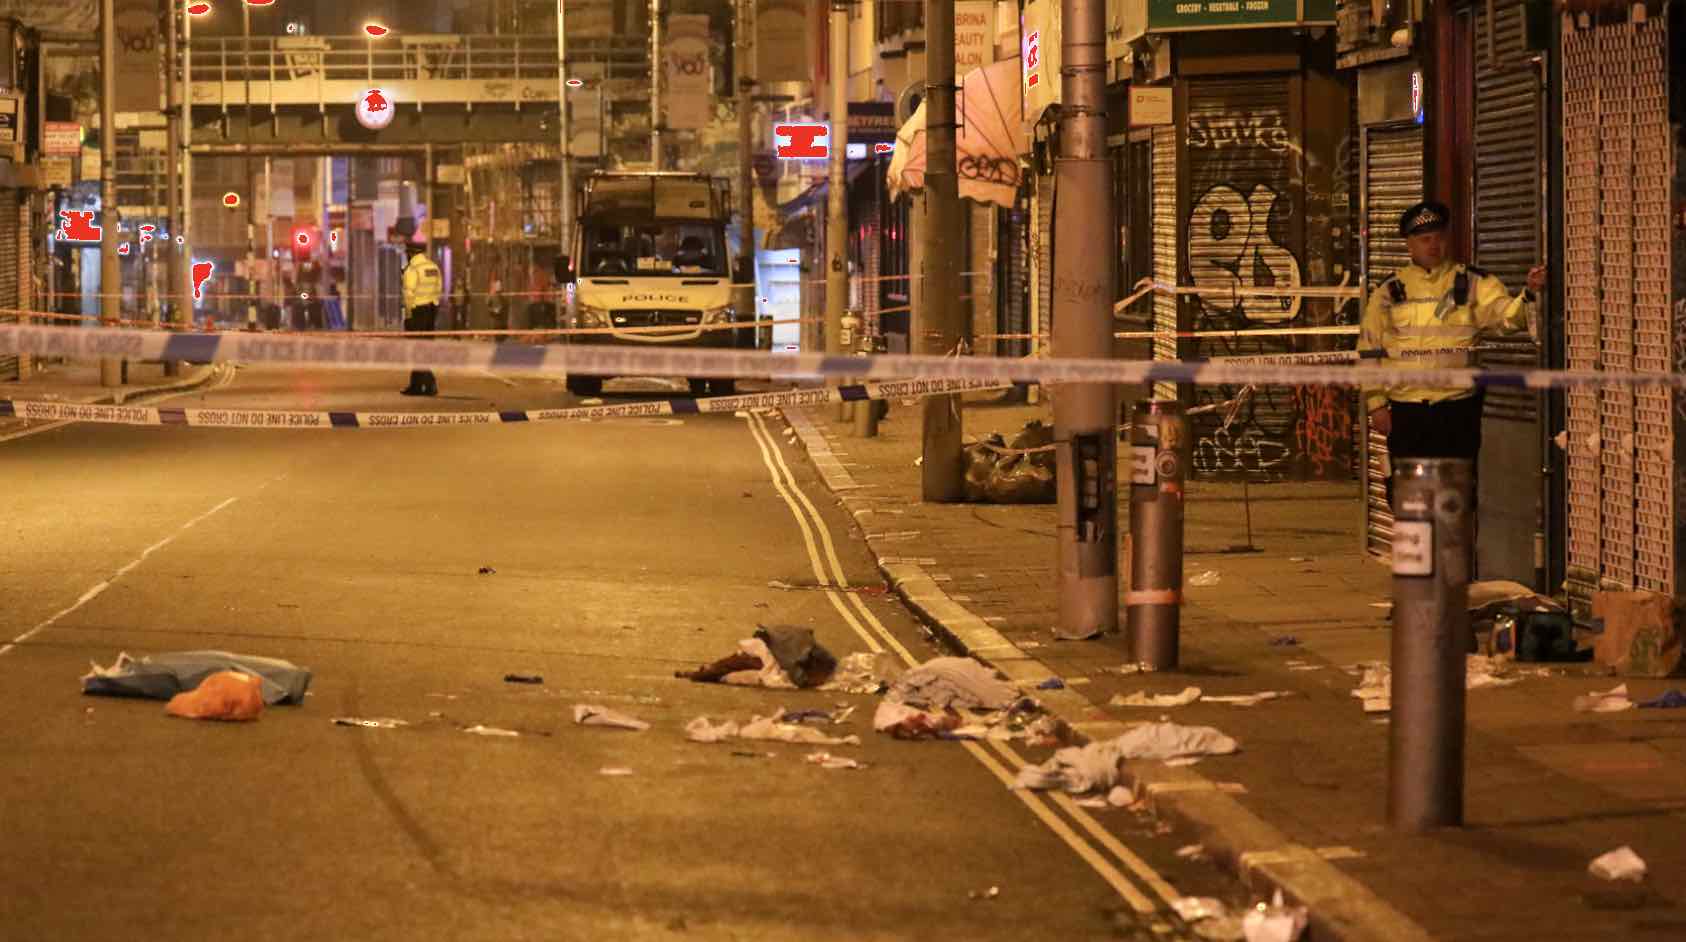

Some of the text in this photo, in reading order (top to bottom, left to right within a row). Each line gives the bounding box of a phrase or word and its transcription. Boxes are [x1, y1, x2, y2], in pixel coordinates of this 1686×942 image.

[1176, 3, 1202, 14] GROCERY
[623, 295, 688, 303] POLICE
[879, 383, 909, 397] CROSS
[912, 381, 929, 395] NOT
[930, 379, 945, 392] DO
[711, 389, 830, 410] POLICE LINE DO NOT CROSS
[26, 403, 148, 422] POLICE LINE DO NOT CROSS
[570, 409, 589, 419] NOT
[591, 408, 604, 417] DO
[606, 406, 626, 416] LINE
[627, 403, 660, 415] POLICE
[198, 411, 319, 426] POLICE LINE DO NOT CROSS
[368, 415, 399, 426] CROSS
[401, 415, 419, 425] NOT
[420, 415, 435, 425] DO
